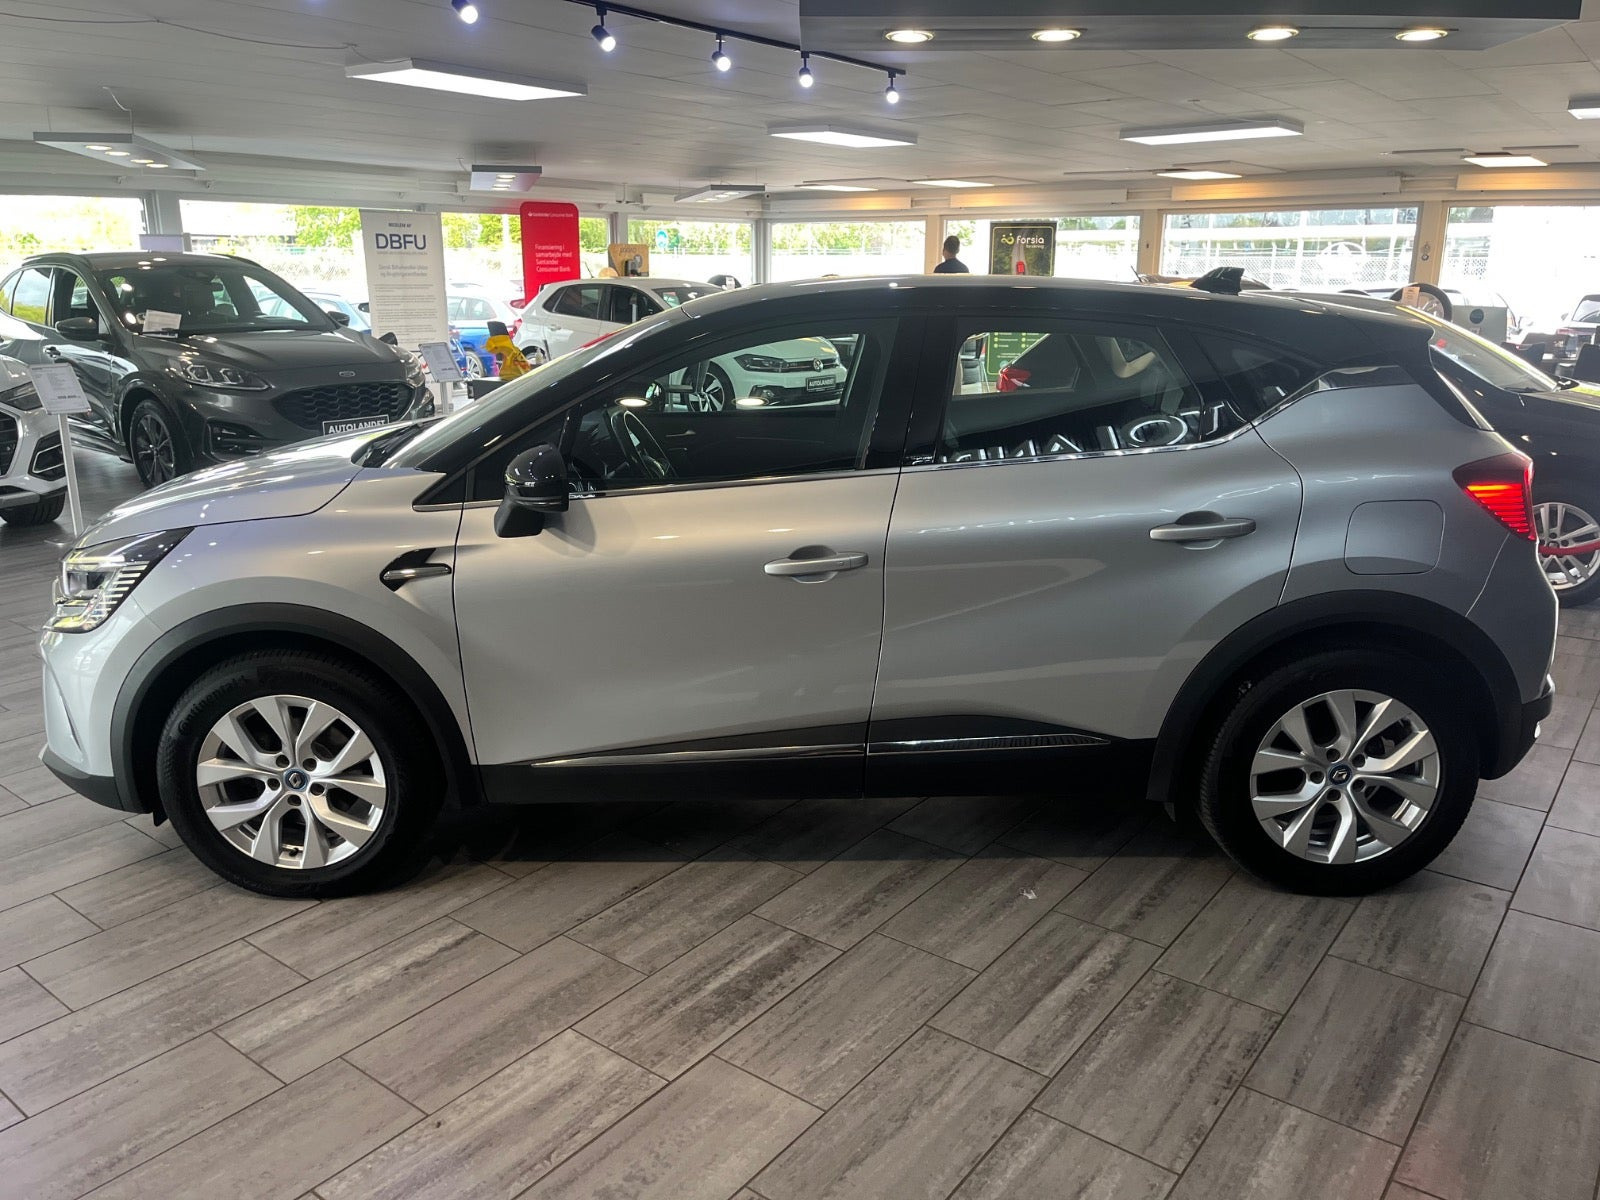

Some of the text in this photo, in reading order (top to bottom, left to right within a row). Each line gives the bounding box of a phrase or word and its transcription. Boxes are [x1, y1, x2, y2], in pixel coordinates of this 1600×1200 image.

[375, 233, 427, 250] DBFU
[1016, 235, 1045, 244] forsia
[328, 419, 386, 434] AUTOLANDET
